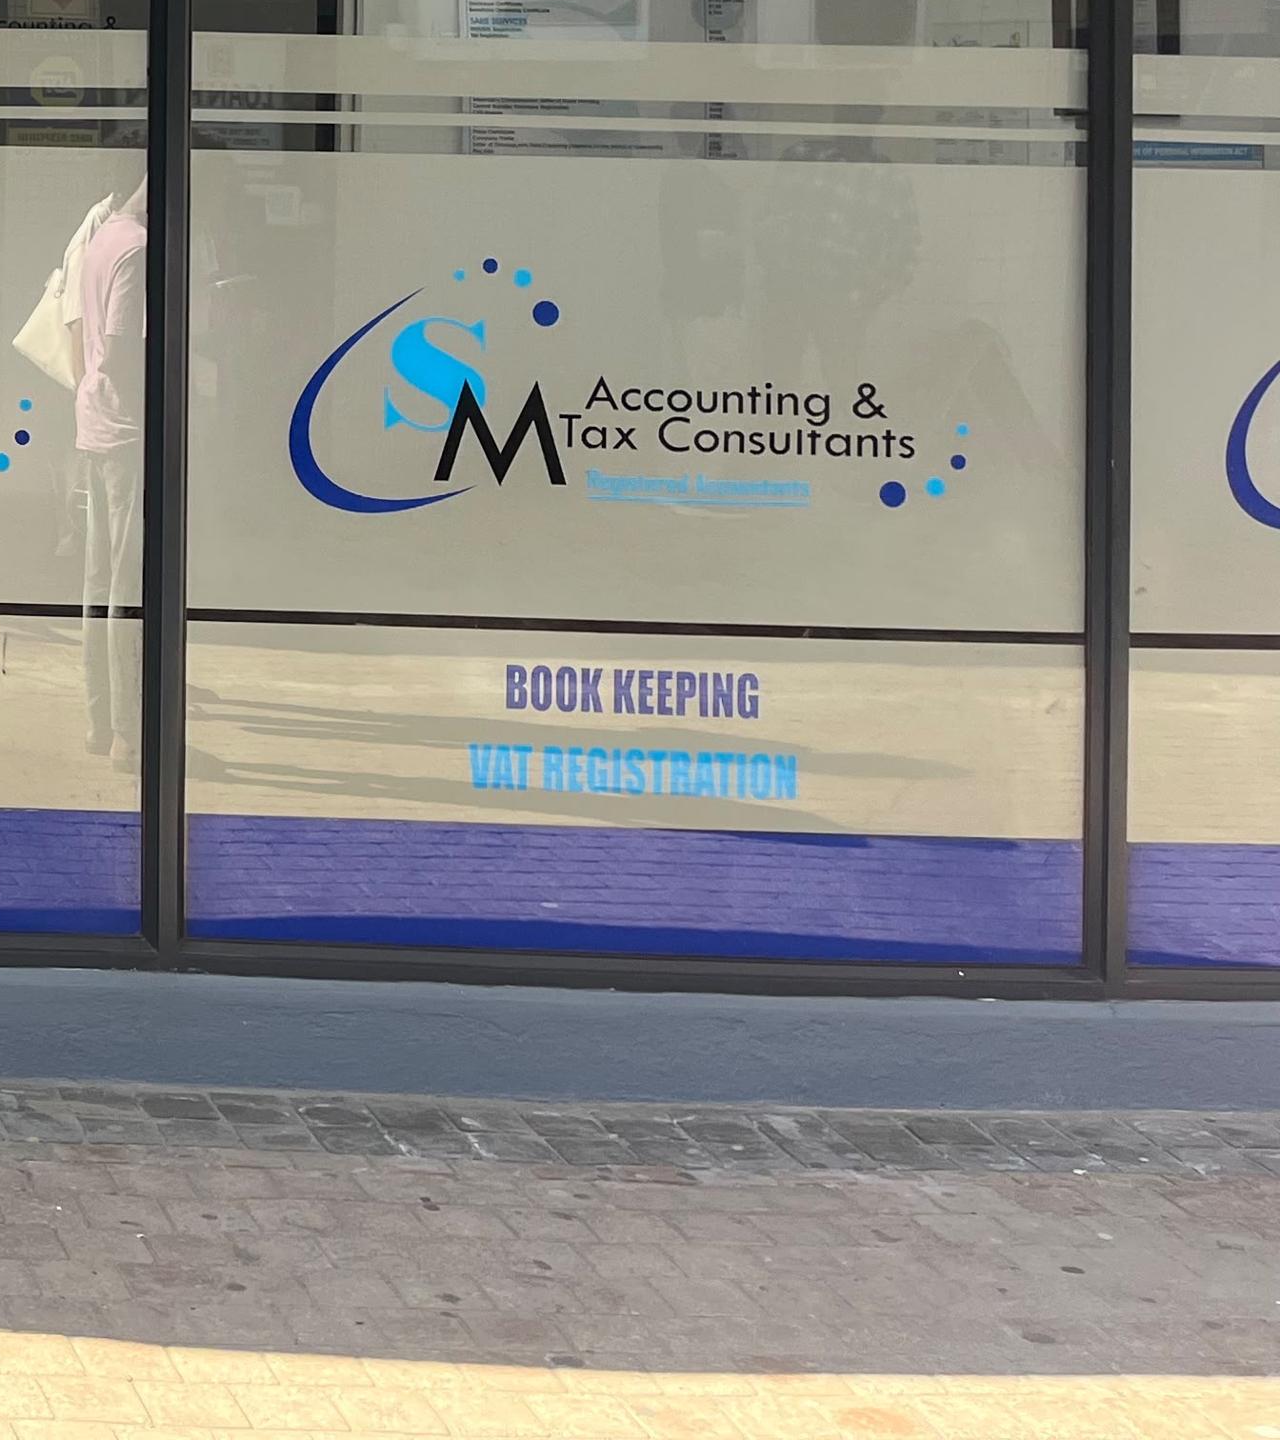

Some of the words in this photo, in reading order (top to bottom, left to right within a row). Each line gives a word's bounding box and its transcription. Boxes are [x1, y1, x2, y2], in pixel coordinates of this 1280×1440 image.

[585, 375, 831, 427] Accounting
[852, 383, 889, 419] &
[559, 413, 638, 451] Tax
[658, 416, 916, 460] Consultants
[505, 663, 604, 715] BOOK
[613, 668, 760, 720] KEEPING
[467, 742, 534, 791] VAT
[542, 744, 798, 801] REGISTRATION
